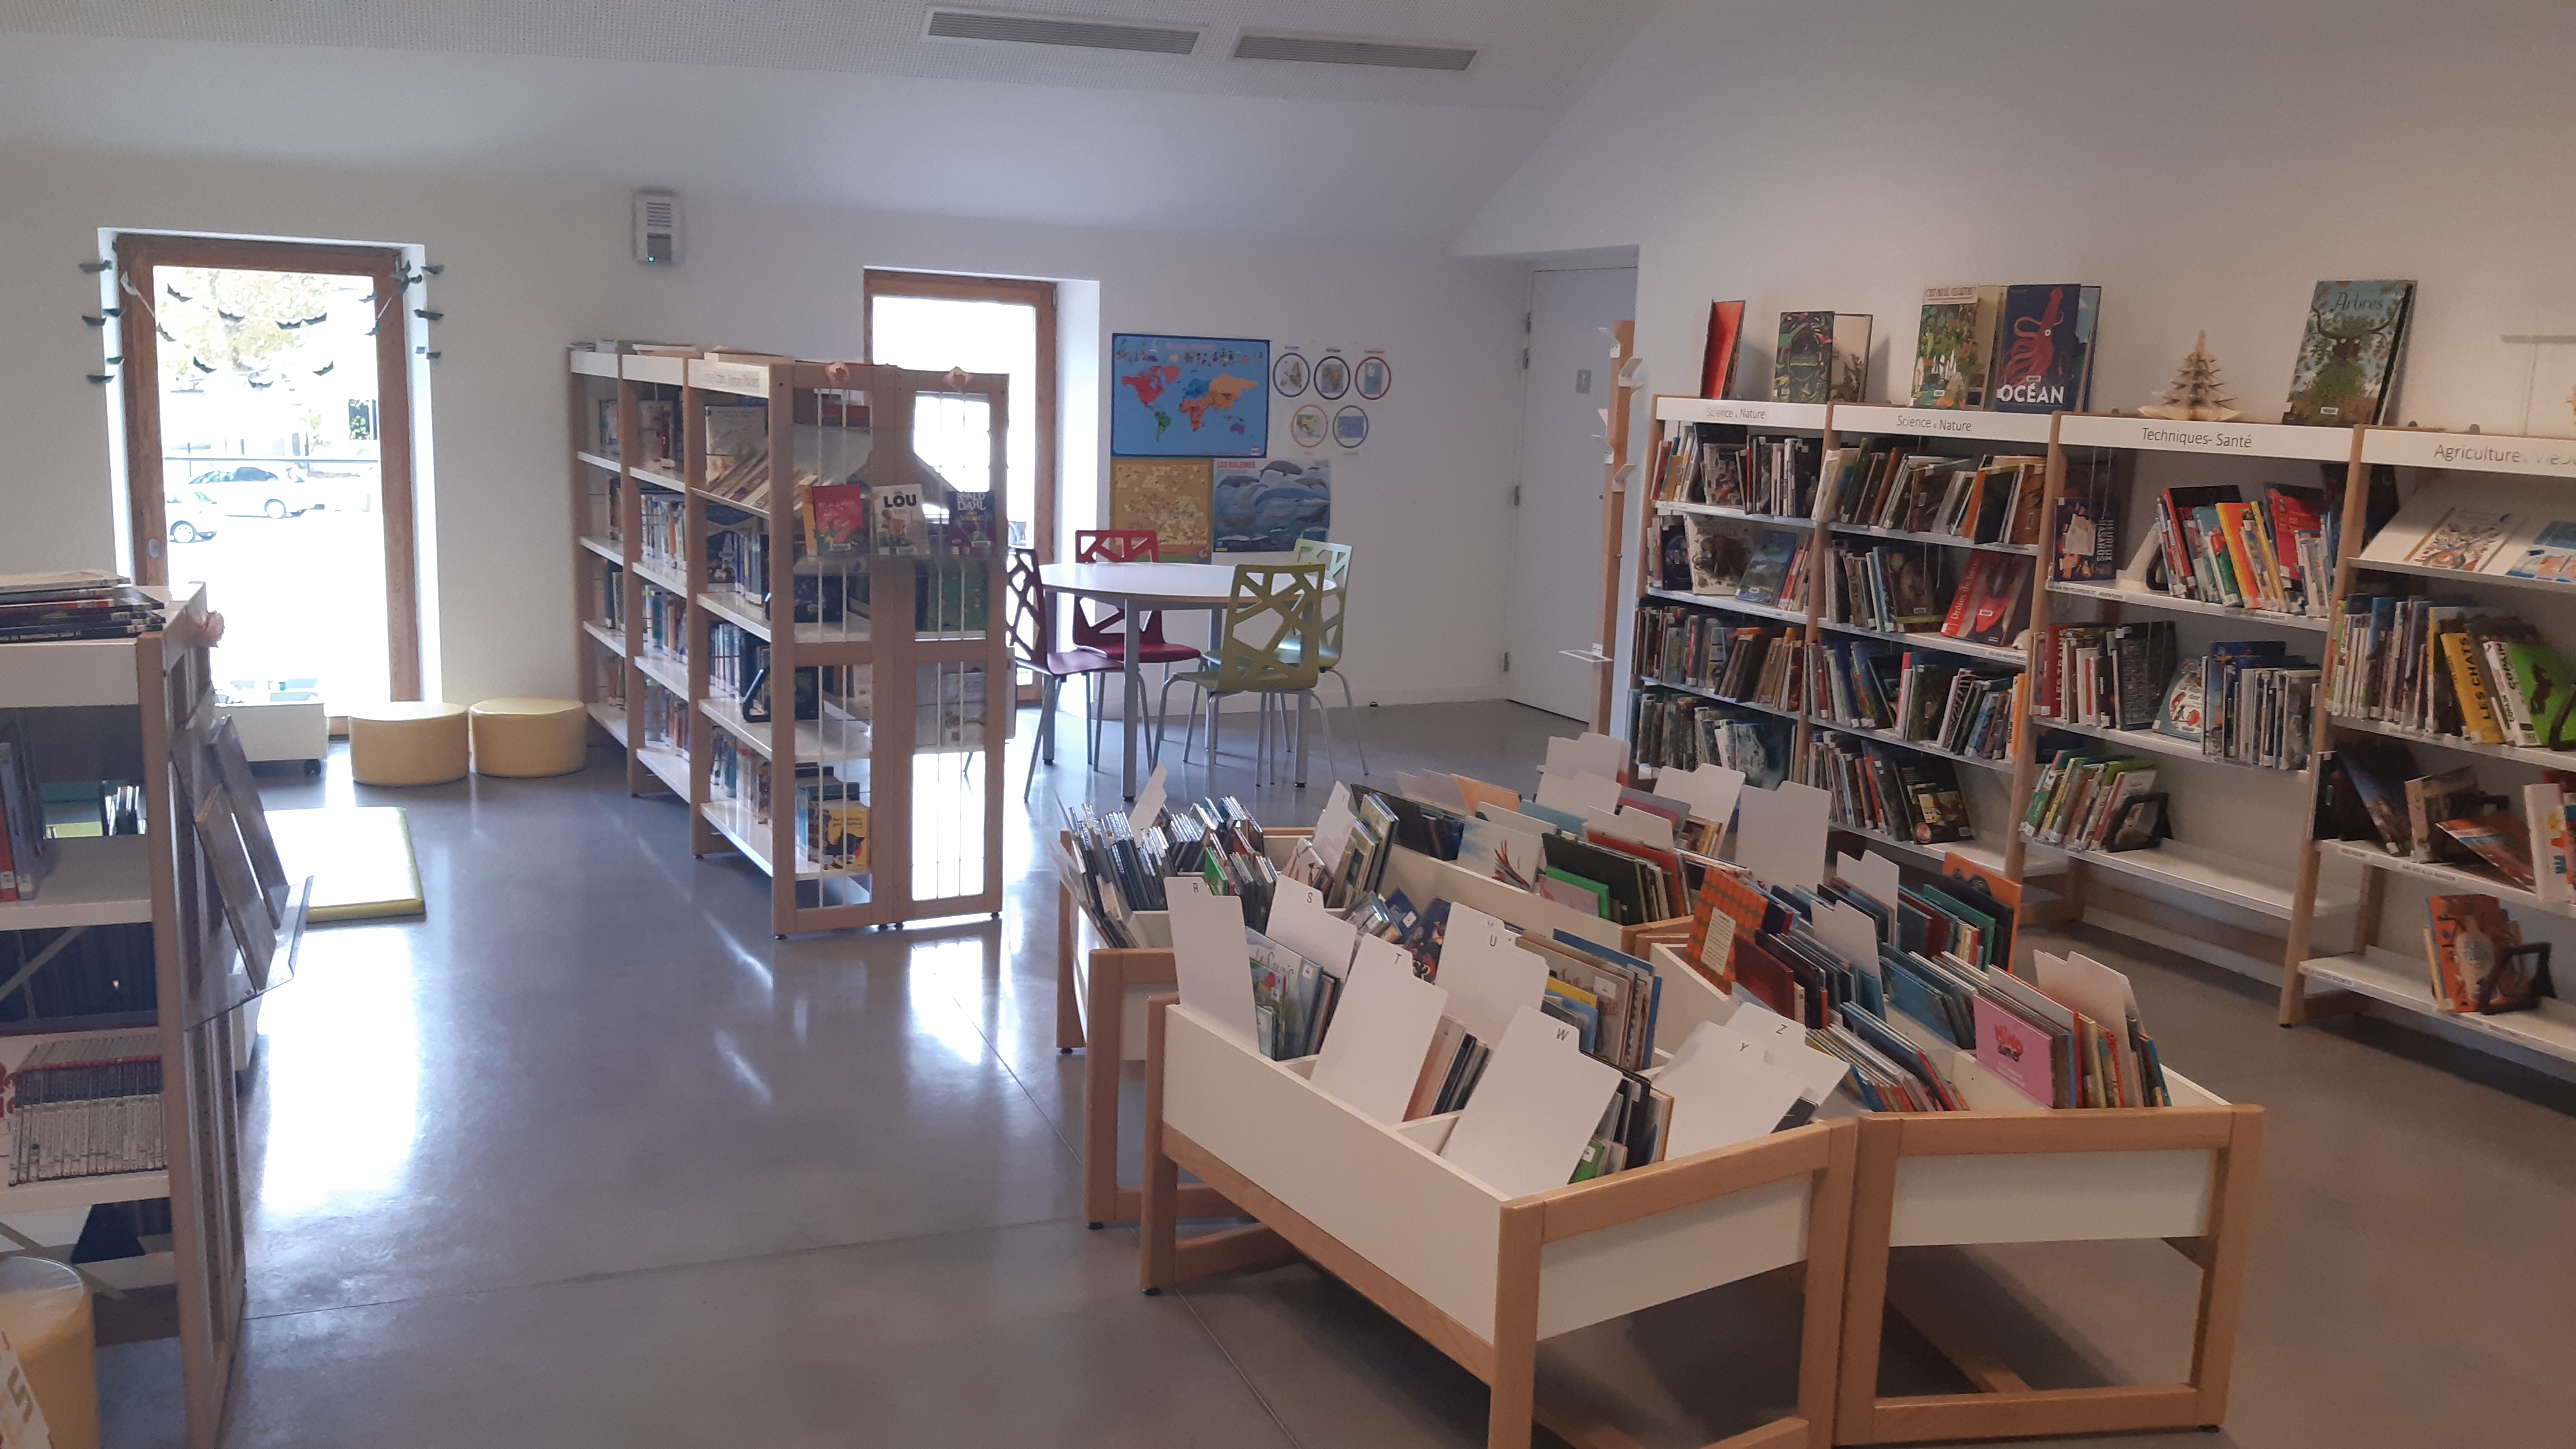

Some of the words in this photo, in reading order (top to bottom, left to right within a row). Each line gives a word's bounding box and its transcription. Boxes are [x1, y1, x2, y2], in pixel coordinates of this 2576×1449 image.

[2330, 292, 2383, 312] Arbres
[2001, 382, 2064, 404] OCÉAN
[1706, 407, 1734, 418] Science
[1740, 408, 1765, 419] Nature
[1897, 415, 1931, 428] Science
[1939, 419, 1972, 432] Nature
[2216, 433, 2252, 448] Santé
[2433, 444, 2521, 462] Agriculture
[883, 494, 917, 508] LOU
[956, 493, 986, 502] ROALD
[958, 500, 986, 511] DAHL
[2104, 520, 2114, 561] HEUREUX
[1950, 594, 1967, 619] Drôles
[2459, 637, 2481, 686] CHATS
[2496, 643, 2517, 690] COPAIN
[2475, 691, 2492, 720] LES
[1192, 882, 1199, 893] R
[1306, 892, 1314, 903] S
[1489, 934, 1498, 947] U
[1394, 952, 1403, 965] T
[1556, 1027, 1570, 1041] W
[1775, 1024, 1788, 1035] Z
[1739, 1042, 1750, 1052] Y
